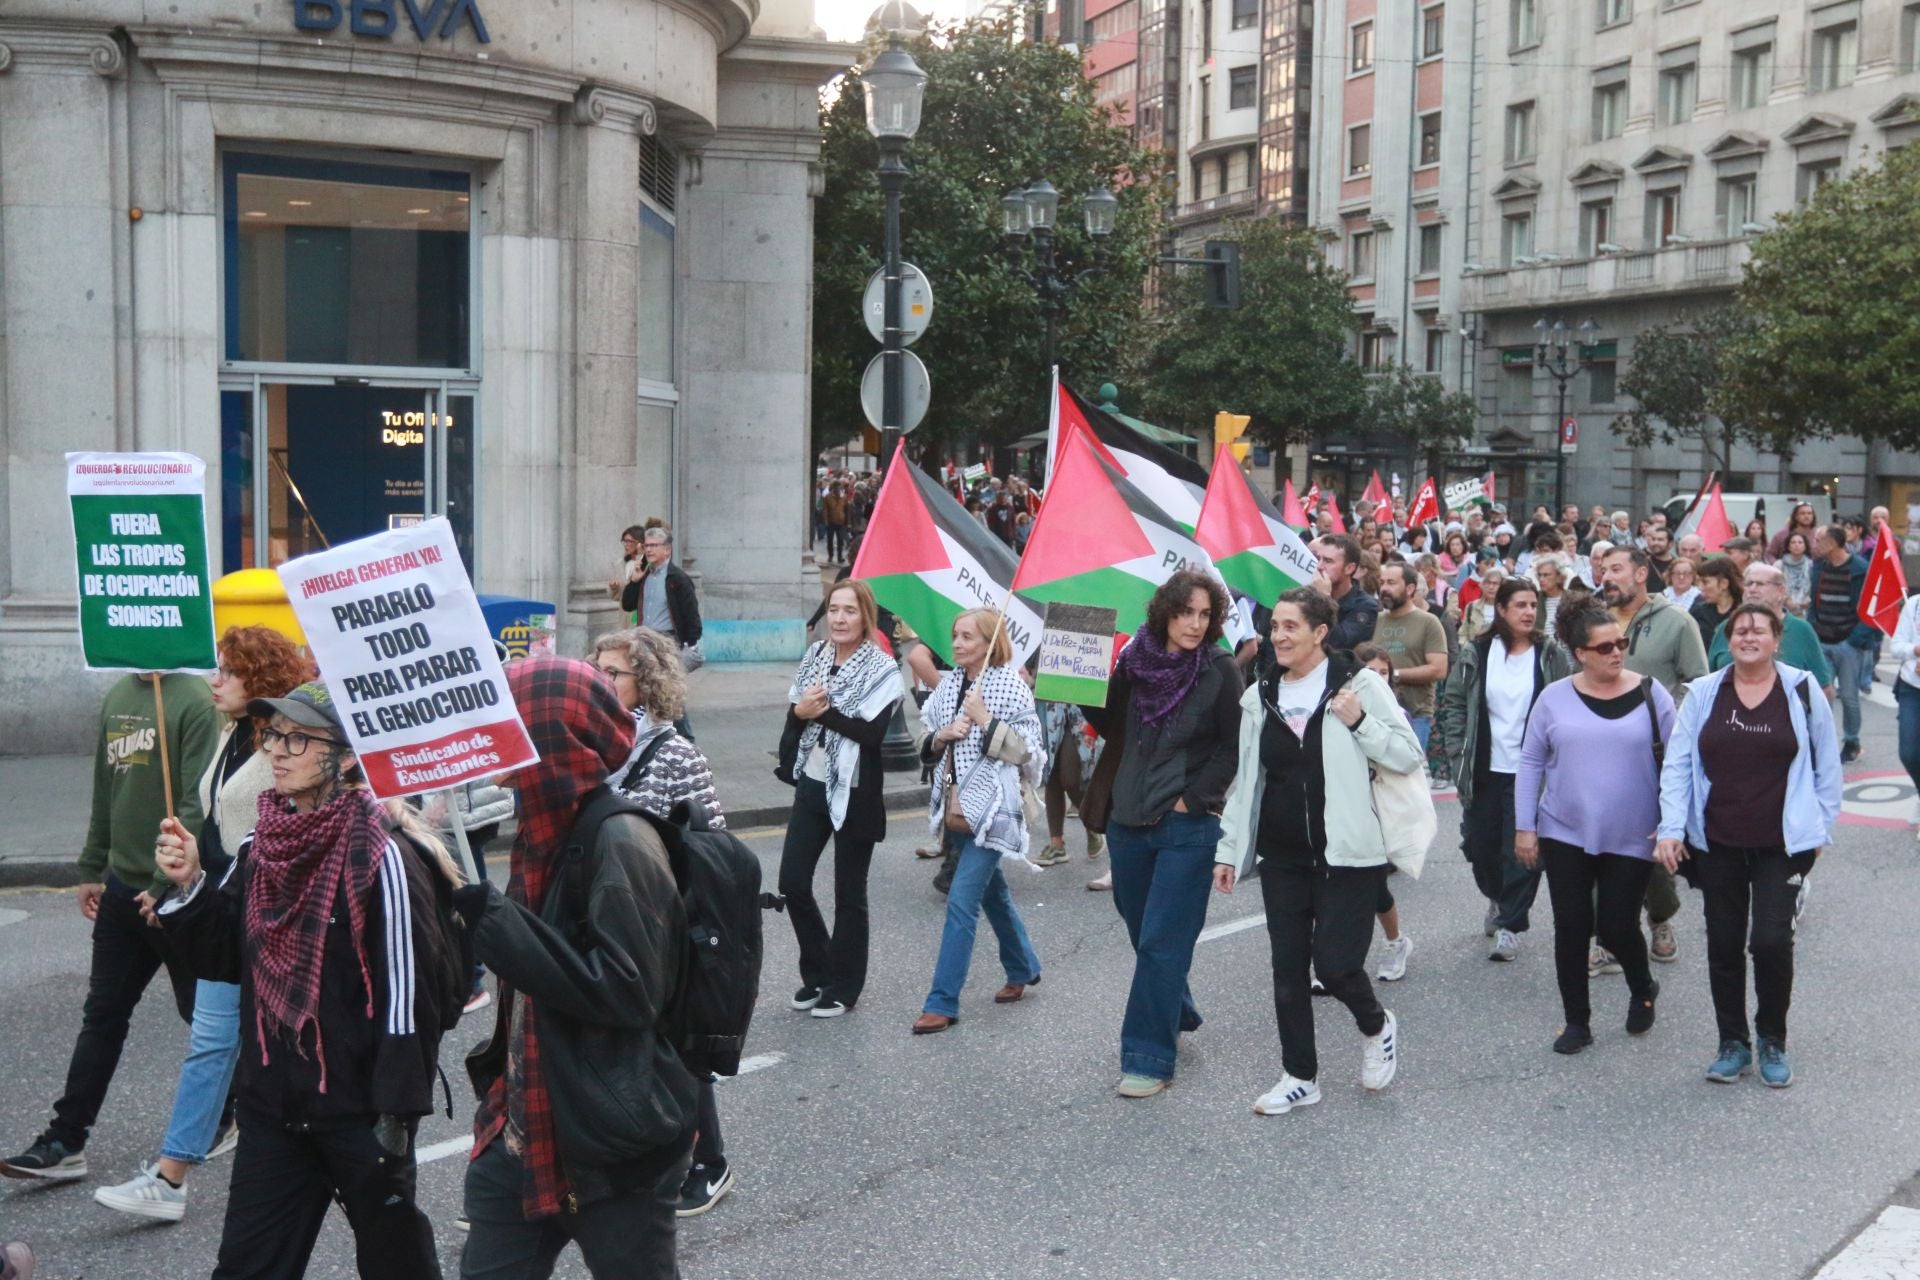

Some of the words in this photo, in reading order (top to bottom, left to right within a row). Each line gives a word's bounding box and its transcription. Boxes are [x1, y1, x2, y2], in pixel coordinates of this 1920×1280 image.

[382, 411, 402, 426] Tu
[110, 513, 162, 535] FUERA
[91, 544, 120, 566] LAS
[121, 544, 185, 566] TROPAS
[300, 568, 358, 599] ¡HUELGA
[358, 551, 420, 582] GENERAL
[419, 545, 443, 566] YA!
[84, 574, 104, 596] DE
[105, 570, 200, 597] OCUPACIÓN
[107, 604, 183, 628] SIONISTA
[331, 582, 436, 633] PARARLO
[957, 566, 1031, 652] PALEINA
[364, 621, 432, 662] TODO
[343, 669, 404, 704] PARA
[400, 646, 482, 691] PARAR
[351, 708, 380, 738] EL
[375, 679, 499, 731] GENOCIDIO
[390, 736, 470, 769] Sindicato
[469, 732, 494, 749] de
[396, 750, 501, 787] Estudiantes
